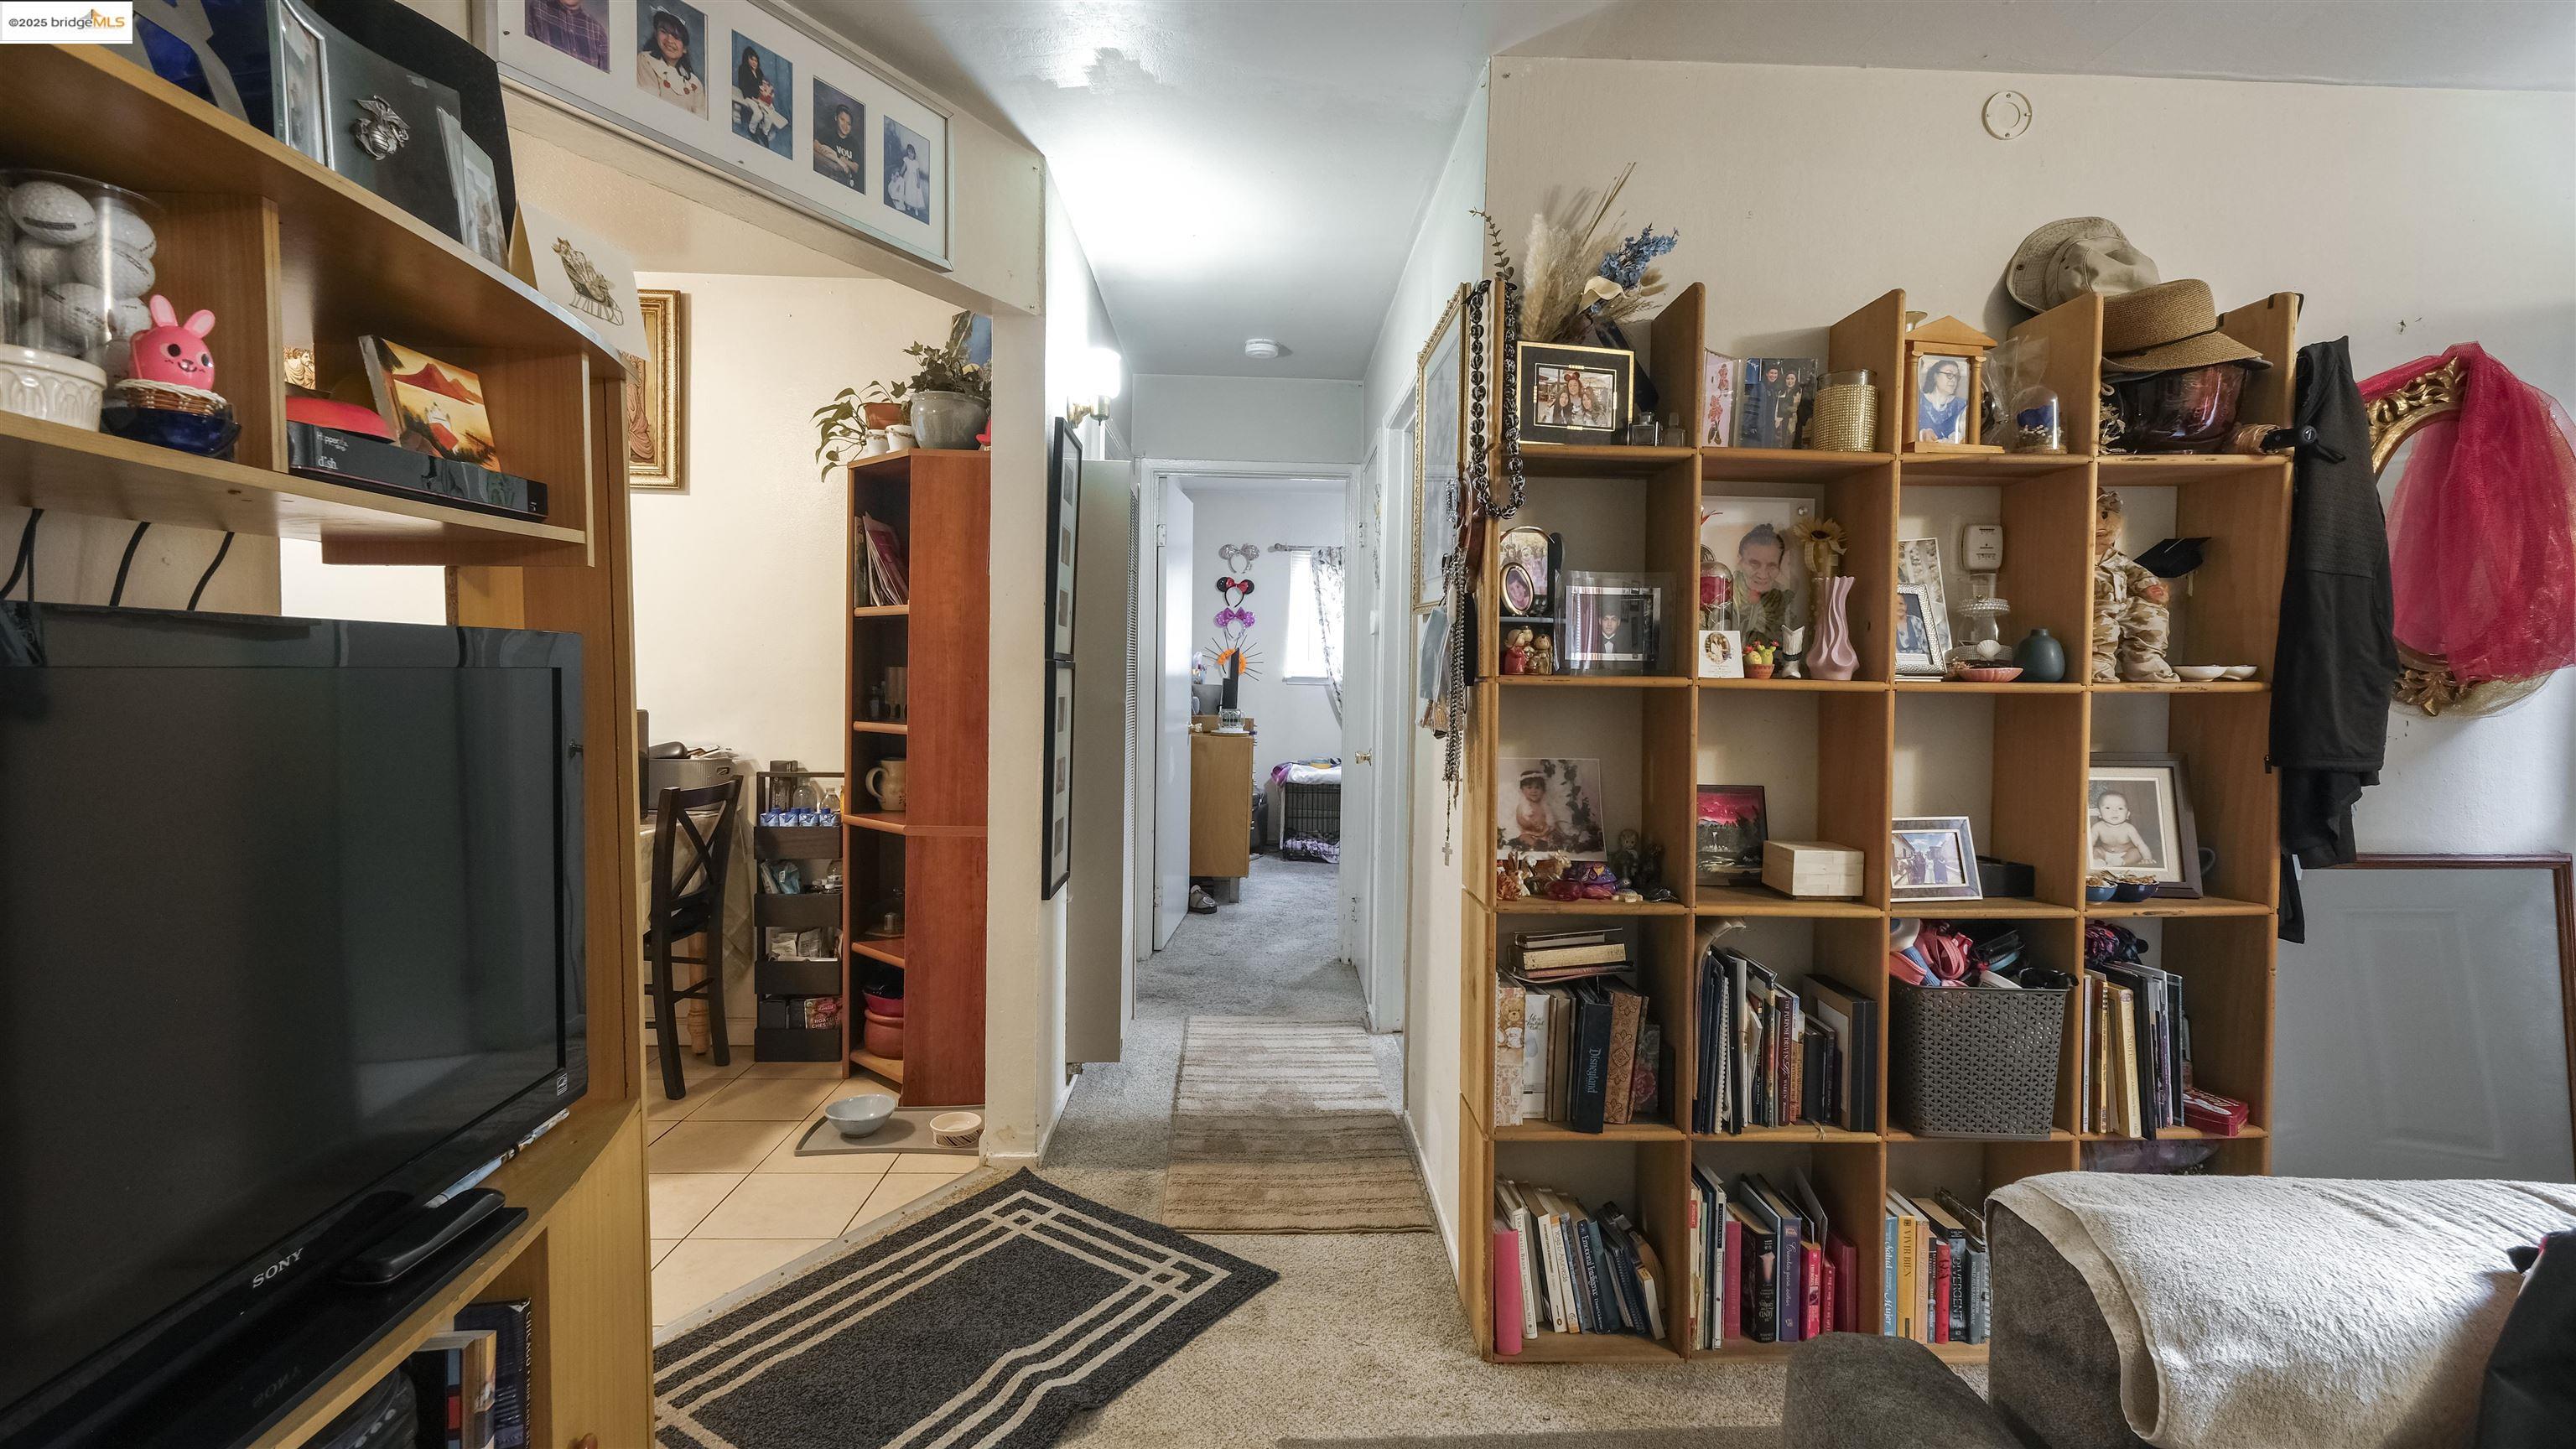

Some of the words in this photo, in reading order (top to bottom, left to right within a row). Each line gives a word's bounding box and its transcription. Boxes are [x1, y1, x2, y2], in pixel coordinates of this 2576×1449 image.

[1586, 1046, 1602, 1093] Disneyland
[1785, 1242, 1796, 1270] Cuentos
[1884, 1241, 1894, 1269] Salud
[1903, 1230, 1912, 1254] VIVIR
[252, 1248, 304, 1289] SONY
[1557, 1253, 1568, 1282] Ayurveda
[1581, 1235, 1593, 1265] Emotional
[1587, 1265, 1599, 1296] Intelligence
[1903, 1256, 1912, 1277] BIEN
[1952, 1257, 1963, 1321] DIVERGENT
[1884, 1292, 1893, 1326] Mujer
